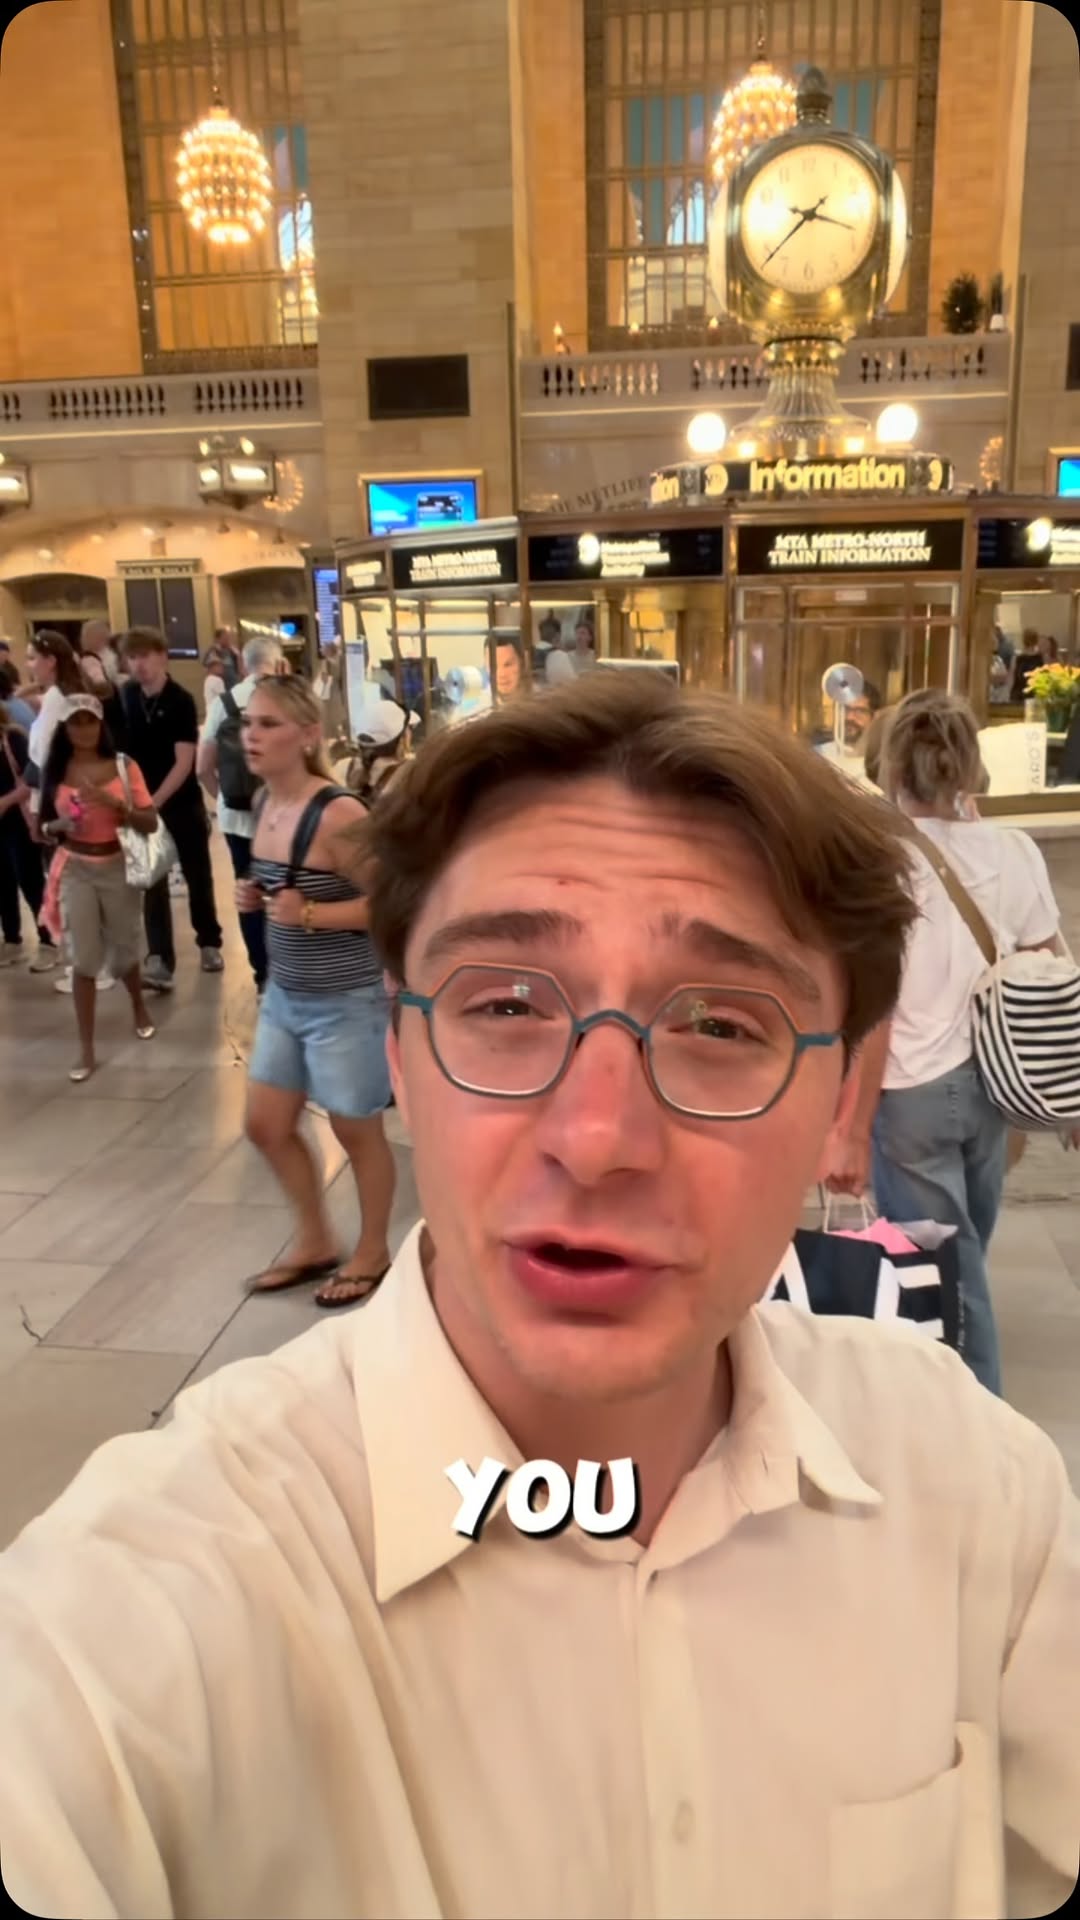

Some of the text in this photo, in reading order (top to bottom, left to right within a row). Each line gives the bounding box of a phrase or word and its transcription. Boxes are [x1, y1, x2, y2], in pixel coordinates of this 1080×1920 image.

[751, 457, 905, 492] Information
[775, 529, 927, 550] MTA METRO-NORTH
[768, 546, 932, 565] TRAIN INFORMATION
